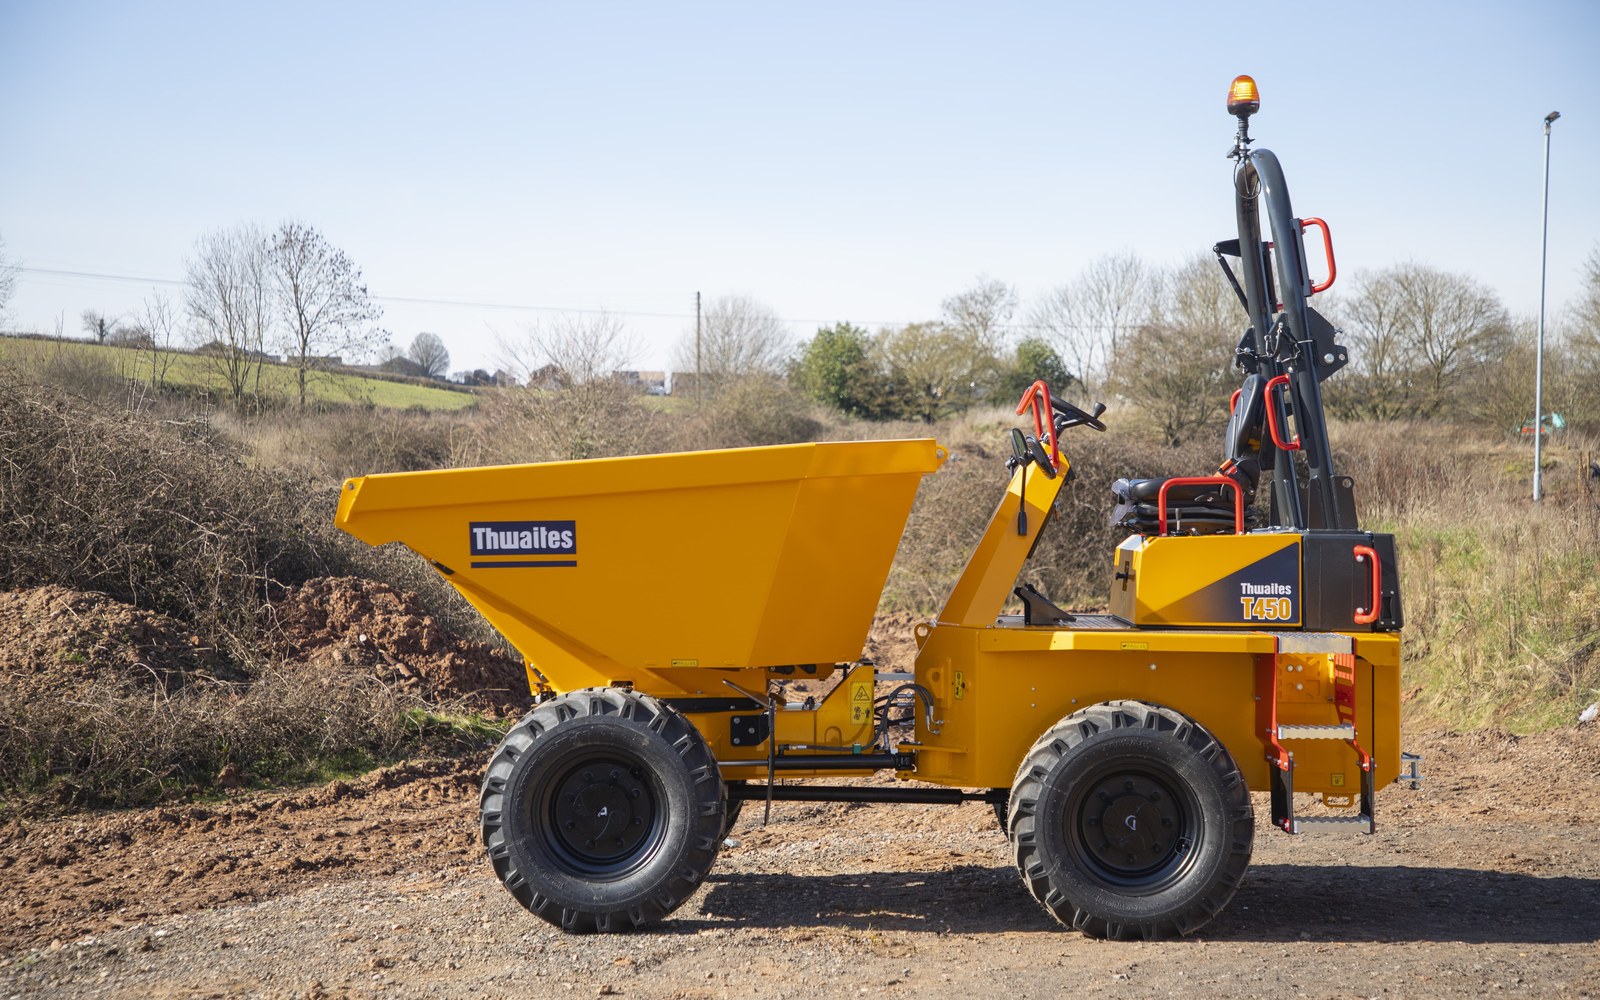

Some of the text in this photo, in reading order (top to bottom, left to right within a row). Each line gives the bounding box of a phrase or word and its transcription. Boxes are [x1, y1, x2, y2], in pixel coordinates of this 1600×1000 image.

[472, 526, 574, 550] Thwaites
[1240, 582, 1292, 595] Thwaites
[1240, 596, 1292, 621] T450
